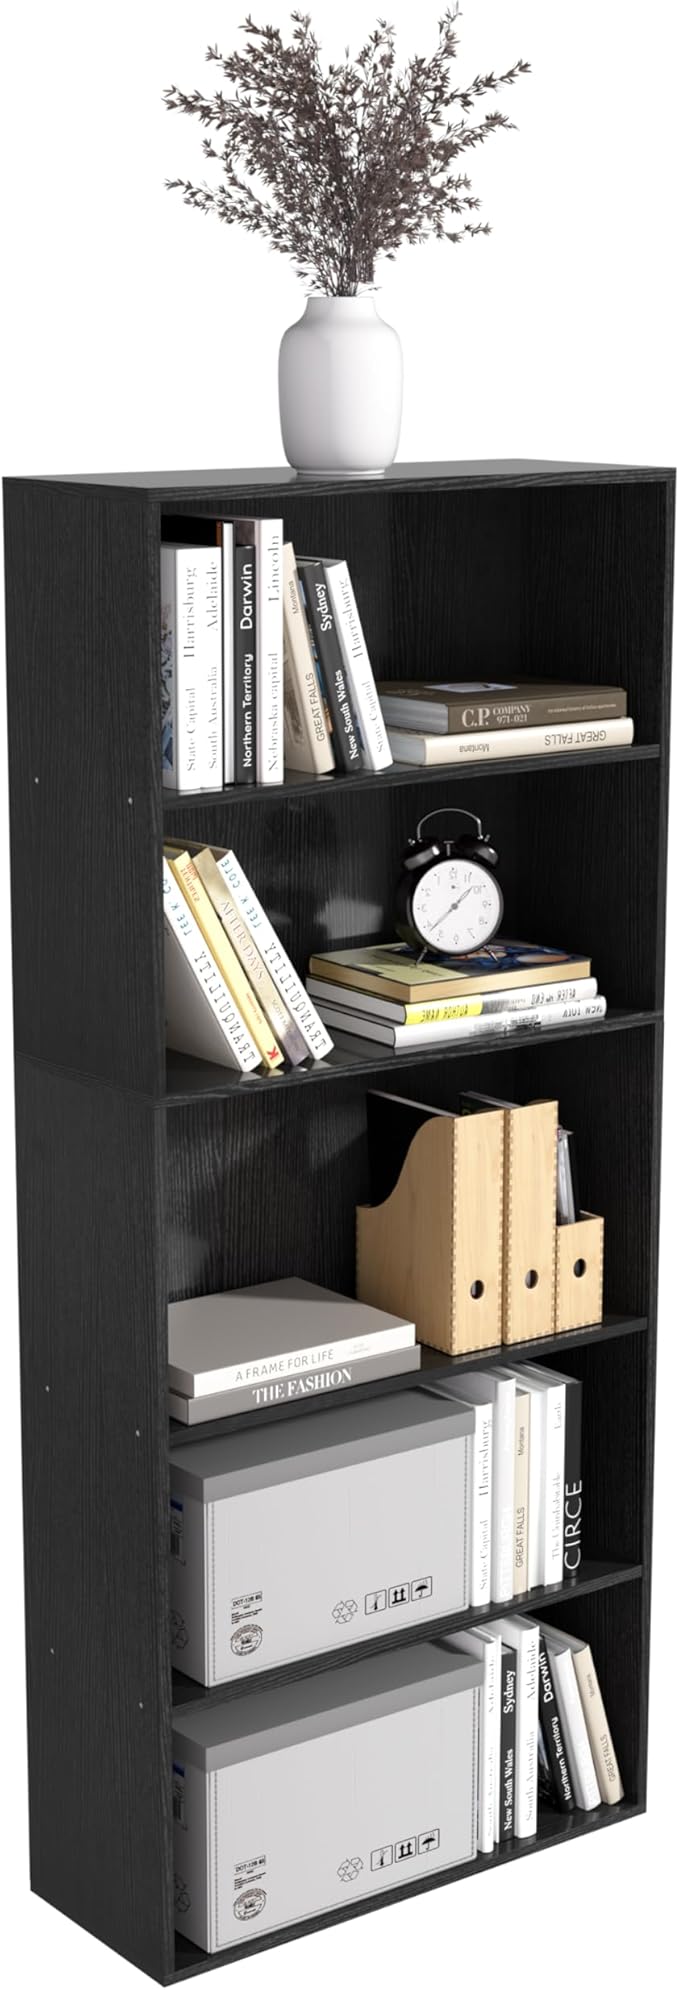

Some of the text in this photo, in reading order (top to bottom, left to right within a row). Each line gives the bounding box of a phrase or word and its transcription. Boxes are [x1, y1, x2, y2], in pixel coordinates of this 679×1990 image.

[183, 567, 197, 658] Harrisburg
[205, 561, 218, 631] Adelaide
[240, 563, 254, 768] Northern Territory Darwin
[267, 535, 280, 771] Nebraska capital Lincoln
[290, 580, 326, 742] GREAT FALLS Montana
[315, 582, 359, 760] New South Wales Sydney
[186, 688, 198, 734] Capital
[207, 666, 218, 726] Australia
[461, 707, 491, 728] C.P.
[492, 704, 531, 715] COMPANY
[496, 713, 528, 725] 971-021
[458, 743, 490, 753] Montana
[544, 729, 607, 746] GREAT FALLS
[235, 1370, 244, 1383] A
[246, 1362, 285, 1380] FRAME
[287, 1355, 309, 1370] FOR
[311, 1348, 335, 1365] LIFE
[252, 1366, 353, 1405] THE FASHION
[478, 1419, 492, 1497] Harrisburg
[515, 1426, 526, 1569] GREAT FALLS Montana
[564, 1479, 583, 1570] CIRCE
[526, 1640, 537, 1701] Adelaide
[503, 1670, 516, 1831] New South Wales Sydney
[526, 1731, 535, 1785] Australia
[539, 1652, 572, 1801] Northern Territory Darwin
